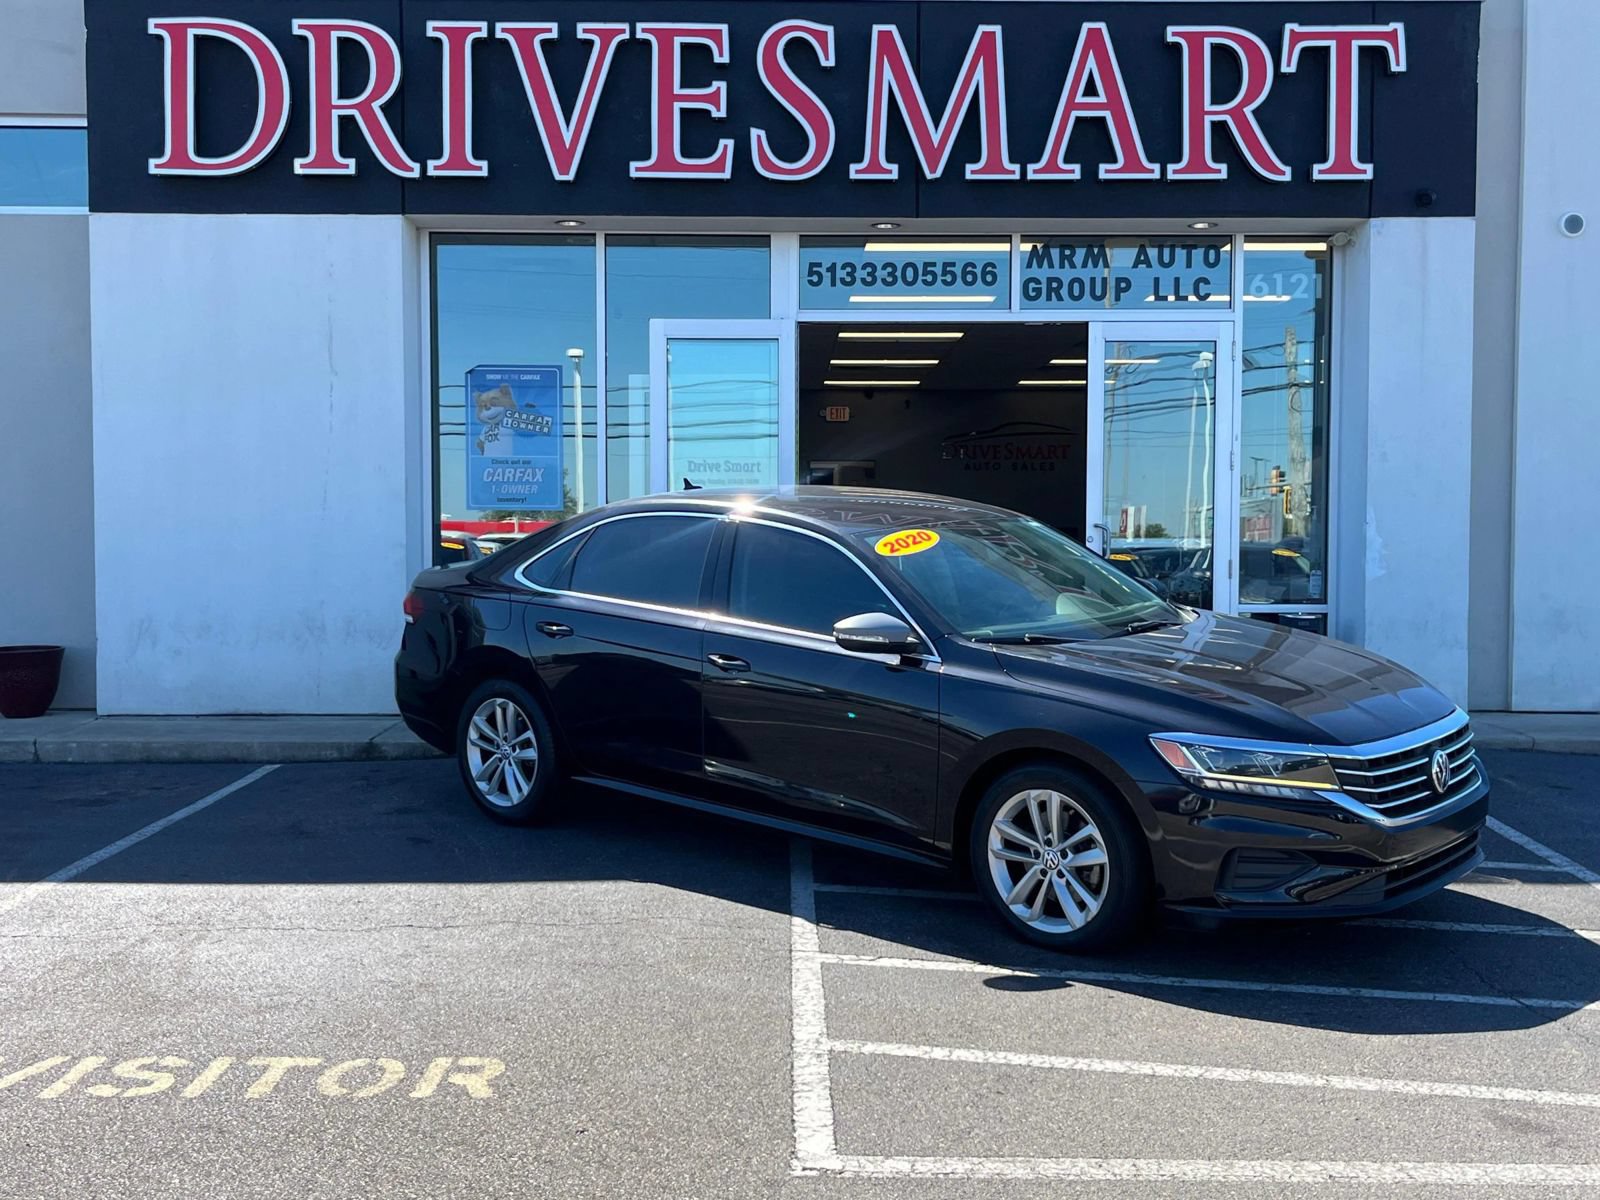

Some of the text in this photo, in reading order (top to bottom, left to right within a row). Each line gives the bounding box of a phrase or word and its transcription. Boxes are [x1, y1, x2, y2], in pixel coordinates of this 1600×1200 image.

[148, 17, 1407, 182] DRIVESMART
[1026, 244, 1221, 269] MRM AUTO
[807, 262, 998, 287] 5133305566
[1249, 273, 1323, 299] 6121
[1022, 276, 1211, 302] GROUP LLC
[505, 409, 552, 426] CARFAX
[830, 407, 847, 420] EXIT
[483, 468, 544, 482] CARFAX
[688, 460, 761, 473] Drive Smart
[963, 462, 1056, 471] AUTO SALES
[883, 531, 932, 554] 2020
